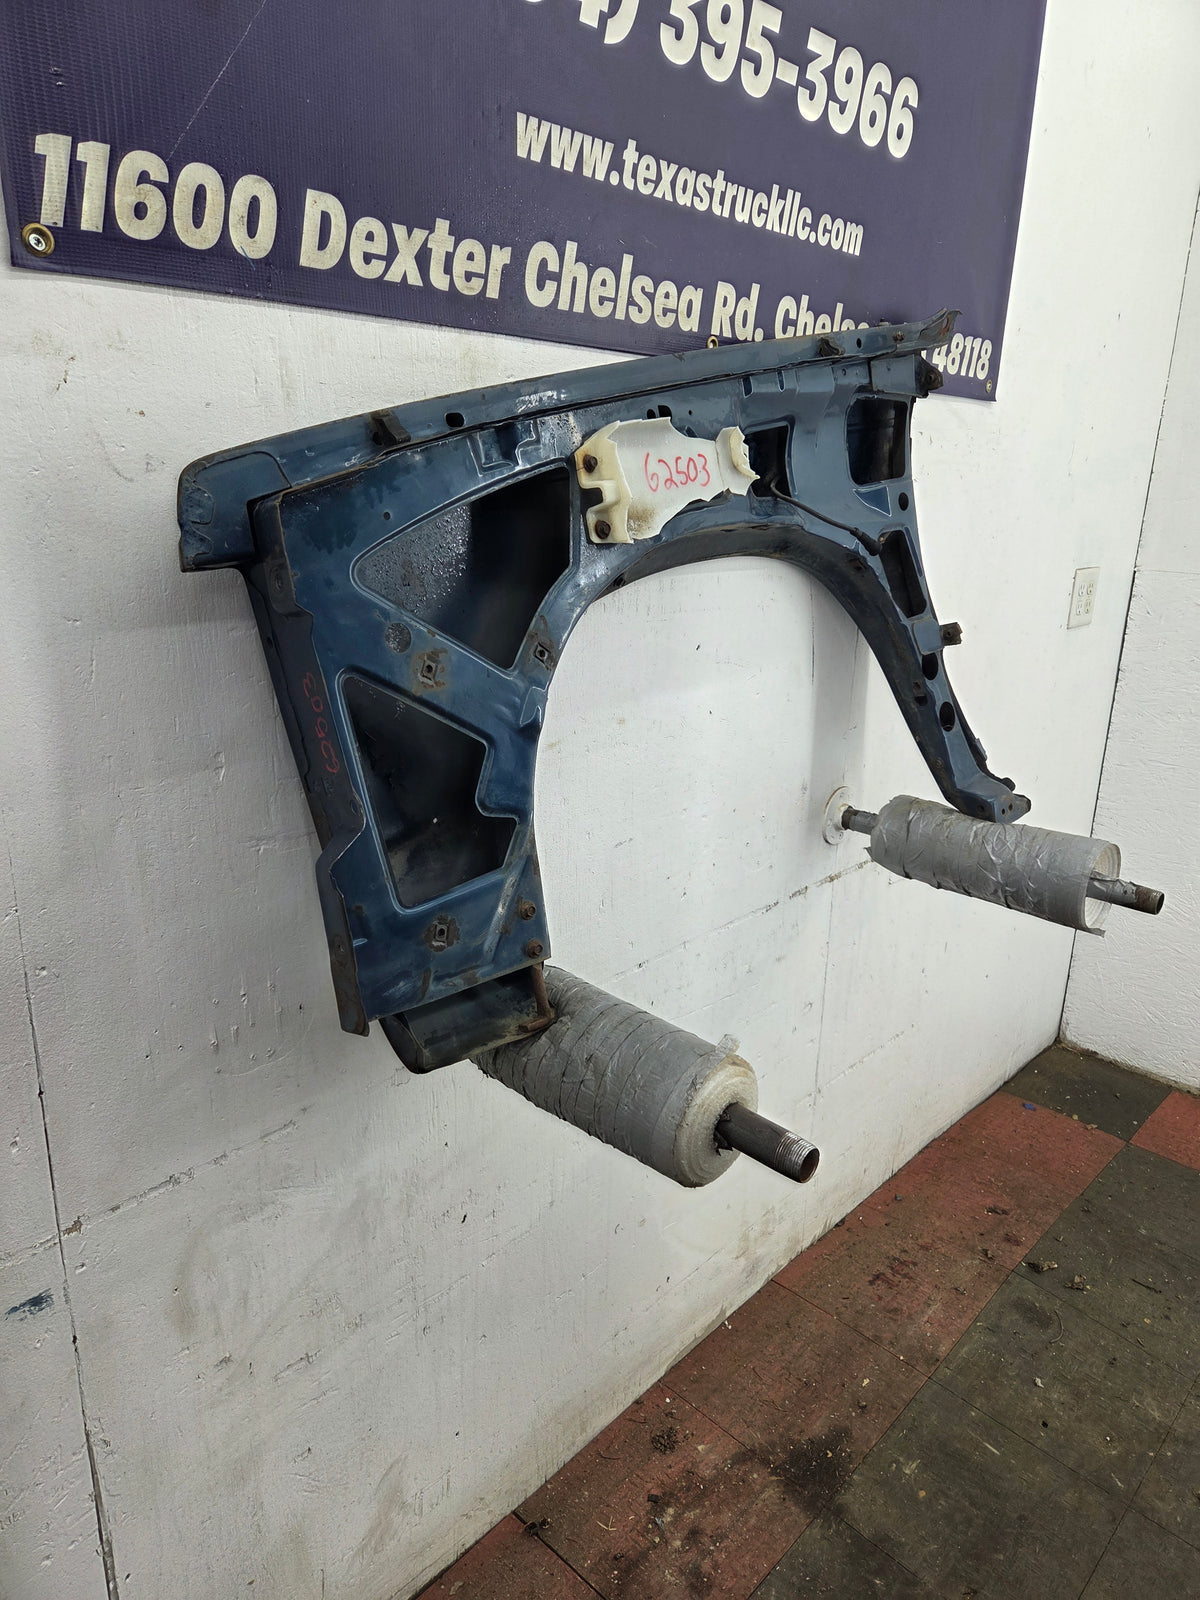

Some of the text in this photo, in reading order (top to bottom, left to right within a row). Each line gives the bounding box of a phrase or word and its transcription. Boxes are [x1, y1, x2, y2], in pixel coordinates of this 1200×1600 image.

[660, 0, 919, 160] 395-3966
[35, 133, 278, 259] 11600
[300, 189, 512, 299] Dexter
[525, 241, 704, 333] Chelsea
[710, 281, 764, 343] Rd.
[775, 294, 870, 339] Chel
[932, 333, 993, 380] 48118
[516, 112, 864, 256] www.texastruckllc.com
[643, 452, 711, 493] 62503
